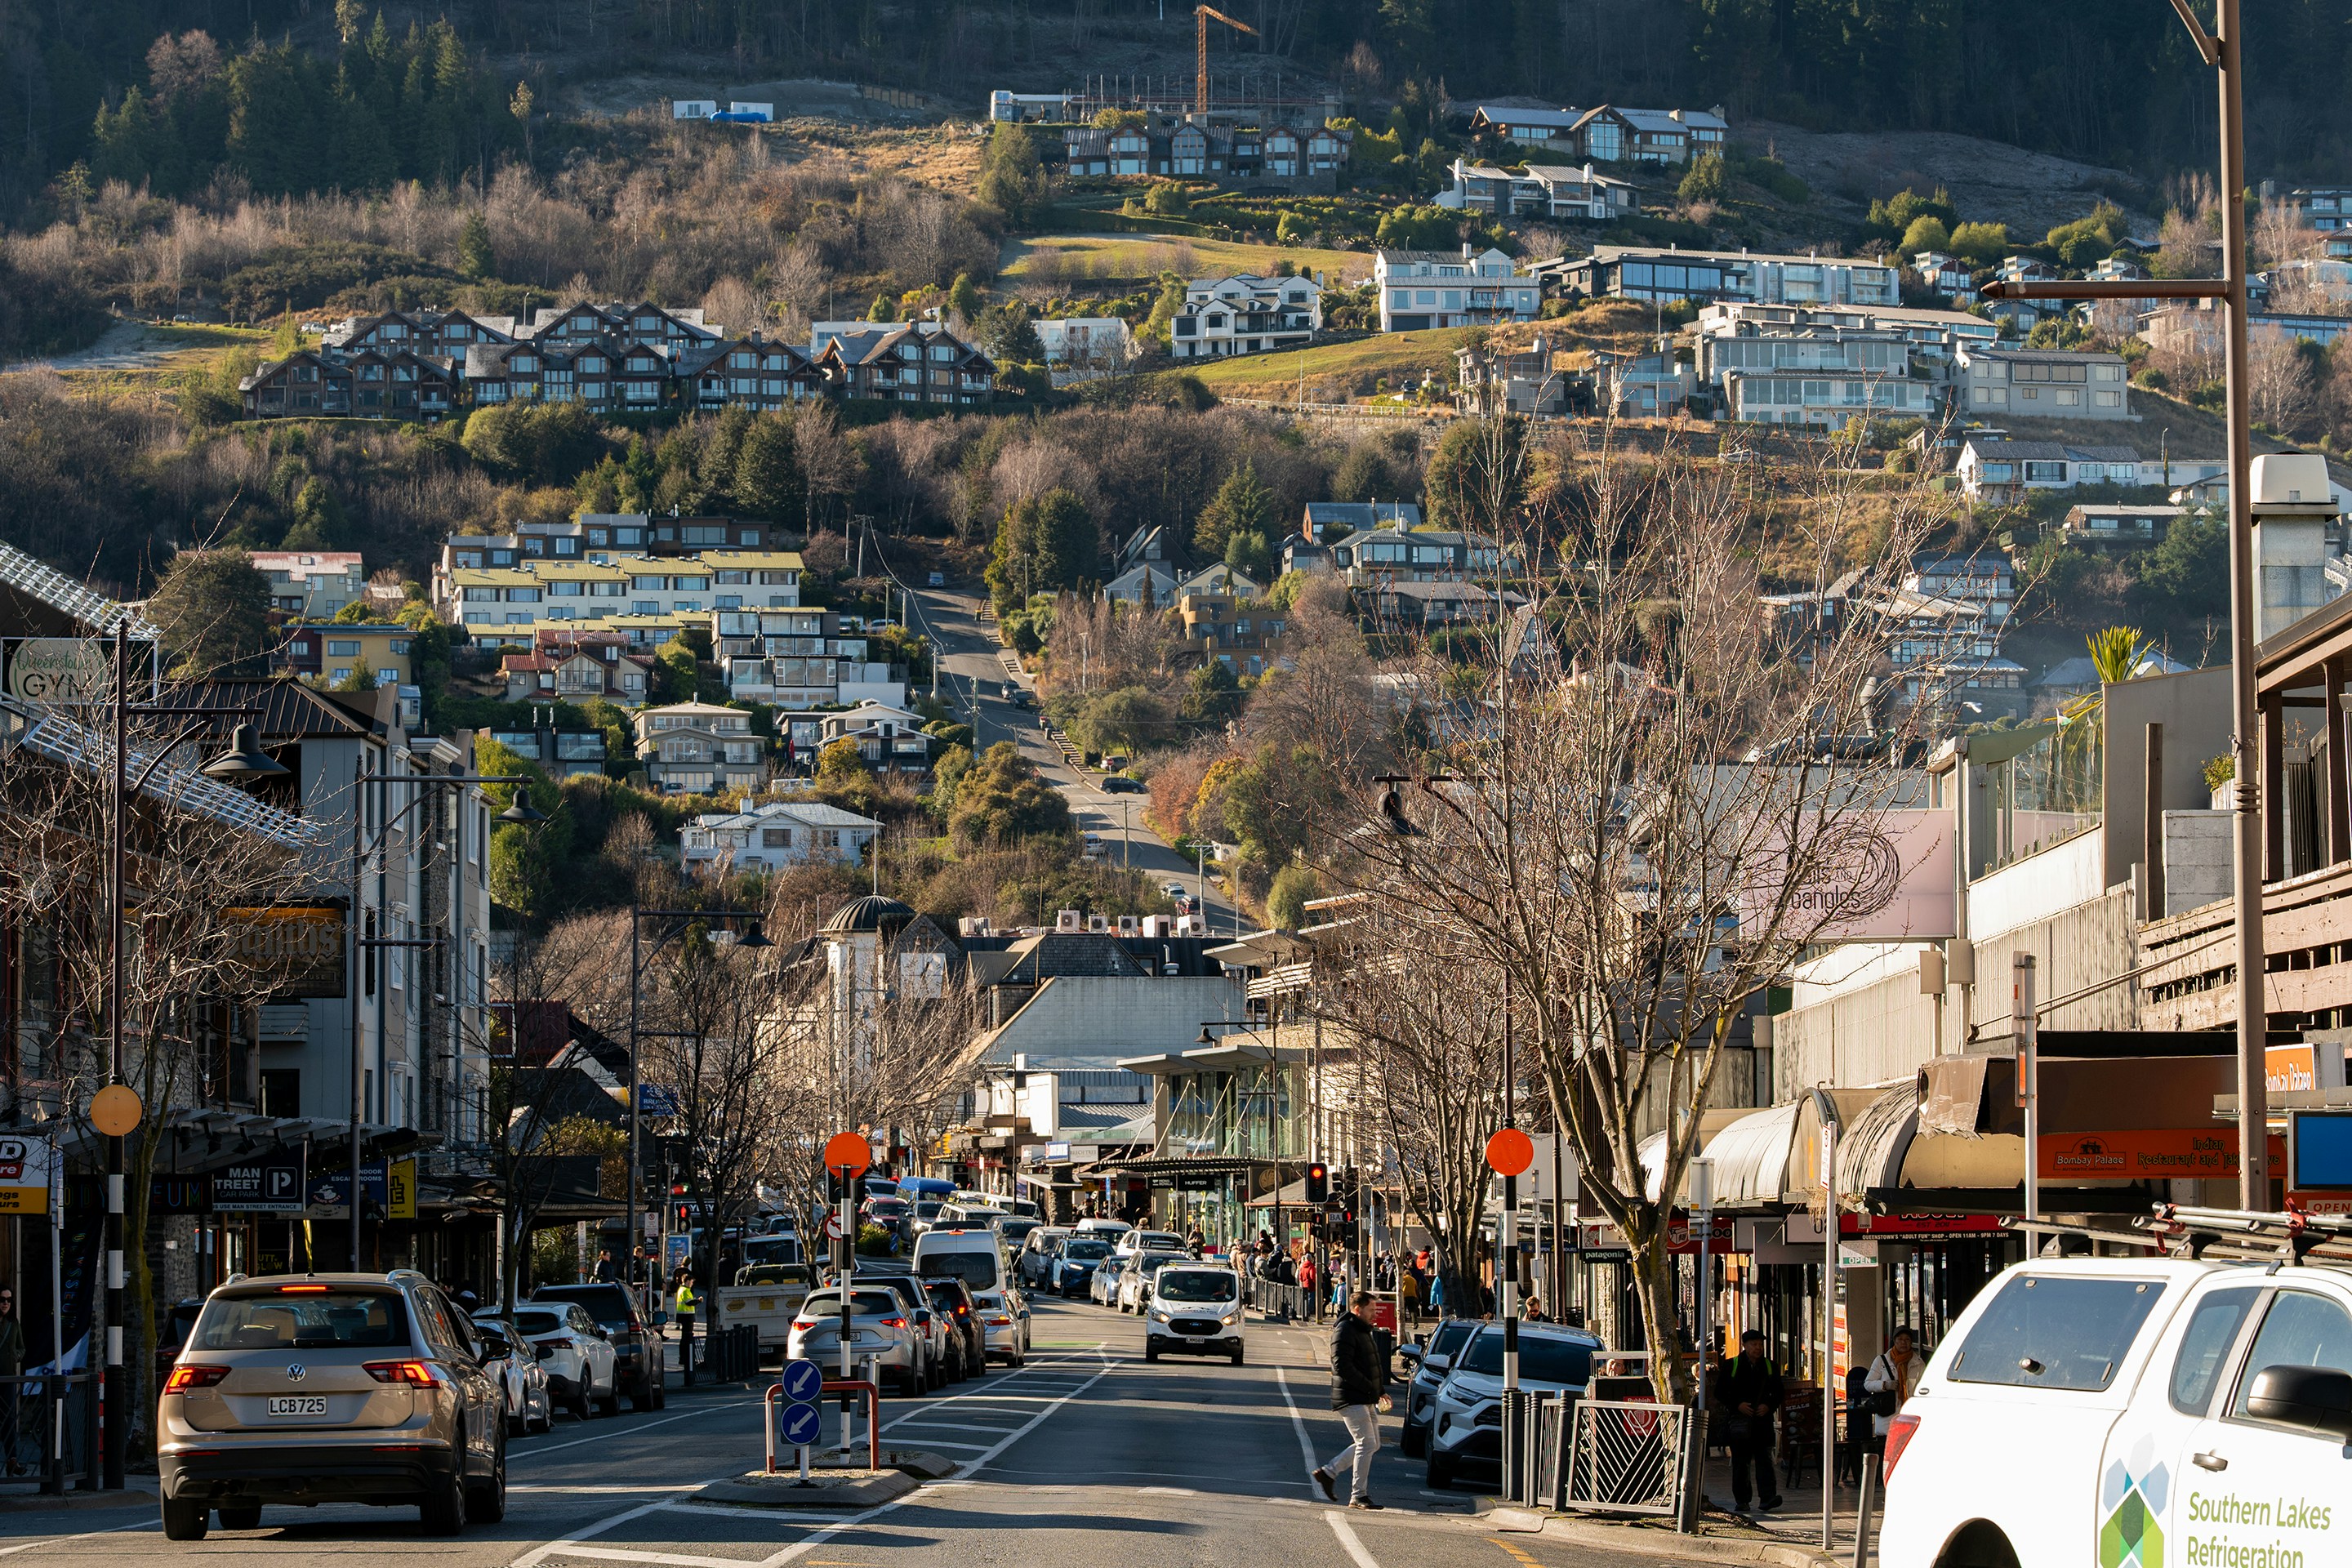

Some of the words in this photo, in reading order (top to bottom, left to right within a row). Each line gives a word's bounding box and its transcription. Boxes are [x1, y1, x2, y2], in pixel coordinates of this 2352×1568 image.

[2194, 1137, 2225, 1152] Indian
[2056, 1155, 2092, 1167] Bombay
[2095, 1155, 2124, 1167] Palace
[2138, 1152, 2196, 1169] Restaurant
[2200, 1152, 2219, 1166] and
[2223, 1152, 2280, 1169] Takys
[229, 1168, 260, 1178] MAN
[214, 1179, 260, 1190] TREET
[2313, 1203, 2351, 1213] OPEN
[1585, 1251, 1625, 1260] patagonia
[270, 1399, 325, 1414] LCB725
[2189, 1491, 2271, 1526] Southern
[2276, 1497, 2332, 1530] Lakes
[2187, 1535, 2304, 1568] Refrigeration
